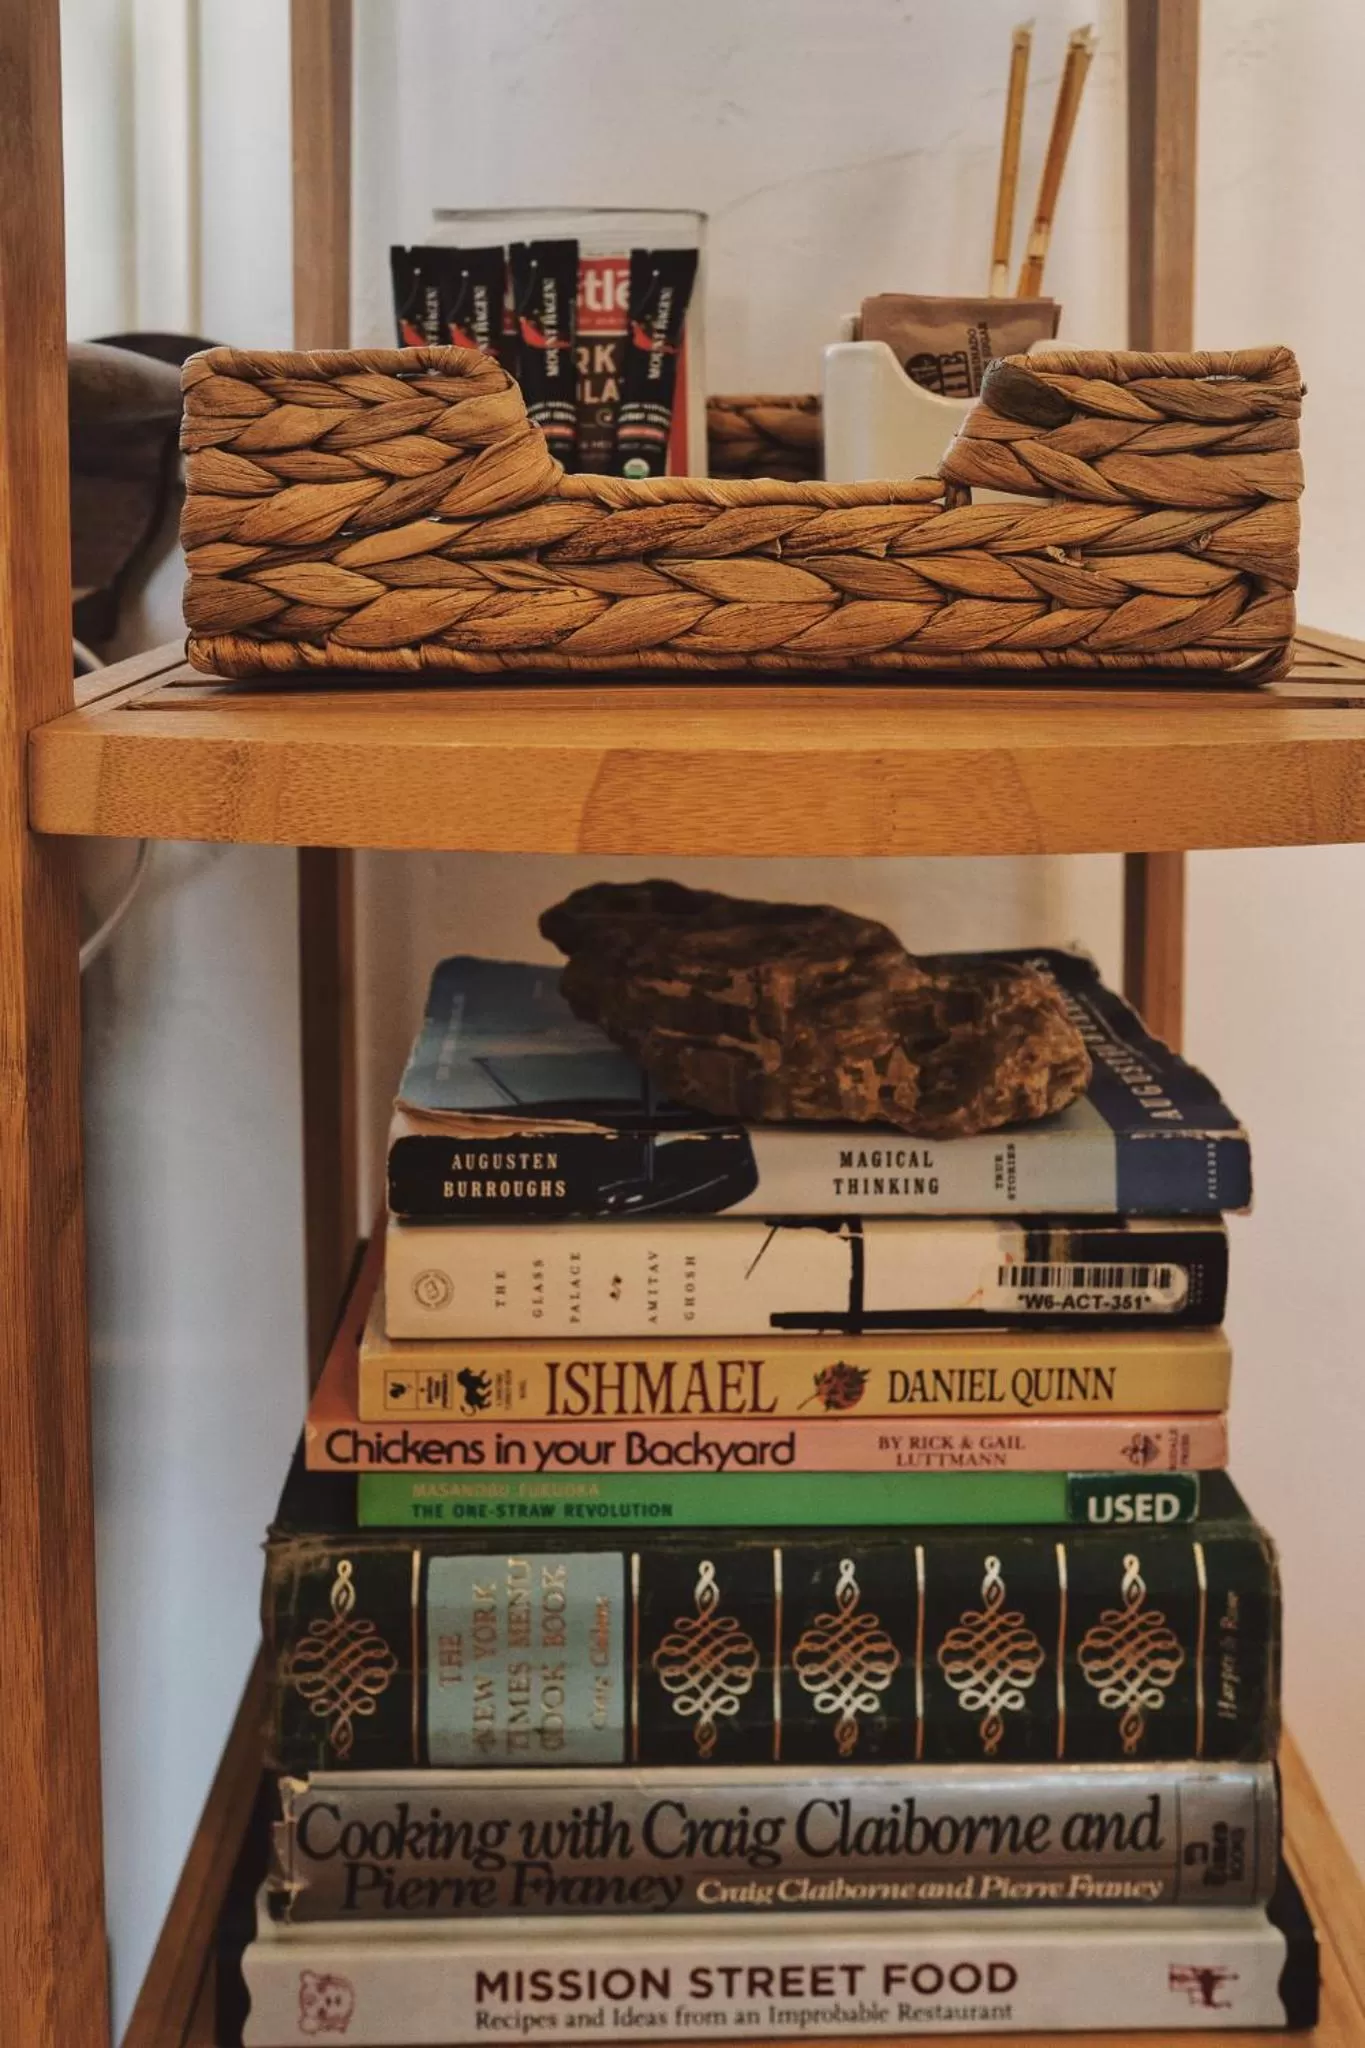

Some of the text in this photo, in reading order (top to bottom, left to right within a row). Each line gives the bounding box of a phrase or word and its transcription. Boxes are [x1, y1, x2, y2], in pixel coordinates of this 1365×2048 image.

[451, 1152, 559, 1171] AUGUSTEN
[839, 1150, 935, 1169] MAGICAL
[995, 1155, 1004, 1190] TRUE
[1006, 1143, 1016, 1200] STORIES
[442, 1179, 568, 1198] BURROUGHS
[832, 1177, 940, 1196] THINKING
[495, 1269, 507, 1308] THE
[532, 1258, 545, 1318] GLASS
[569, 1250, 582, 1324] PALACE
[646, 1249, 659, 1324] AMITAV
[684, 1255, 696, 1321] GHOSH
[545, 1360, 779, 1416] ISHMAEL
[887, 1366, 1117, 1406] DANIEL QUINN
[325, 1428, 797, 1472] Chickens in your Backyard
[878, 1435, 1026, 1450] BY RICK & GAIL
[896, 1452, 1008, 1467] LUTTMANN
[412, 1481, 600, 1499] MASANOBU FUKUOKA
[1088, 1493, 1181, 1524] USED
[411, 1502, 673, 1519] THE ONE-STRAW REVOLUTION
[438, 1632, 464, 1688] THE
[472, 1581, 497, 1753] NEW YORK
[507, 1556, 532, 1754] TIMES MENU
[540, 1563, 568, 1751] COOK BOOK
[298, 1802, 510, 1871] Cooking
[520, 1801, 633, 1861] with
[642, 1799, 785, 1868] Craig
[796, 1797, 1050, 1857] Claiborne
[1061, 1794, 1165, 1854] and
[343, 1860, 685, 1913] Pierre Franey
[696, 1873, 1165, 1905] Craig Claiborne and Pierre Franey
[475, 1962, 1018, 2003] MISSION STREET FOOD
[475, 2001, 1014, 2035] Recipes and Ideas from an Improbable Restaurant
